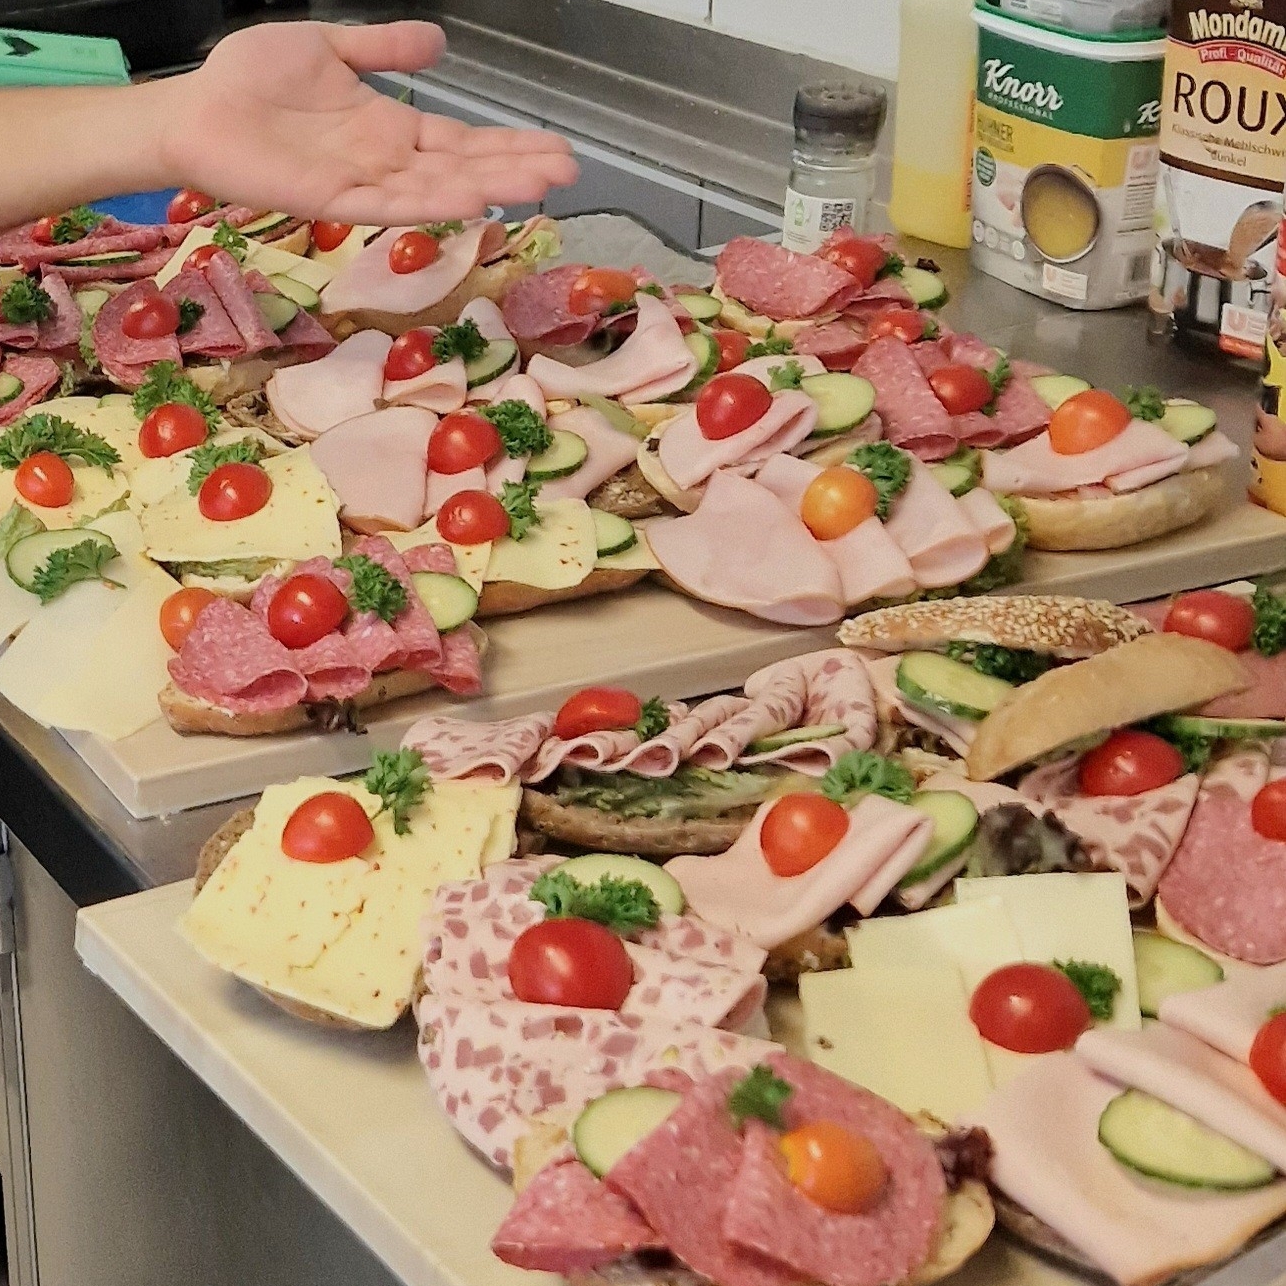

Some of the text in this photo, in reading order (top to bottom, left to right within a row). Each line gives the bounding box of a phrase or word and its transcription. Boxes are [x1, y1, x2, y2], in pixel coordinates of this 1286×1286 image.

[1188, 9, 1286, 52] Mondam
[1200, 48, 1228, 62] Profi
[984, 58, 1064, 111] Knorr
[988, 92, 1054, 121] PROFESSIONAL
